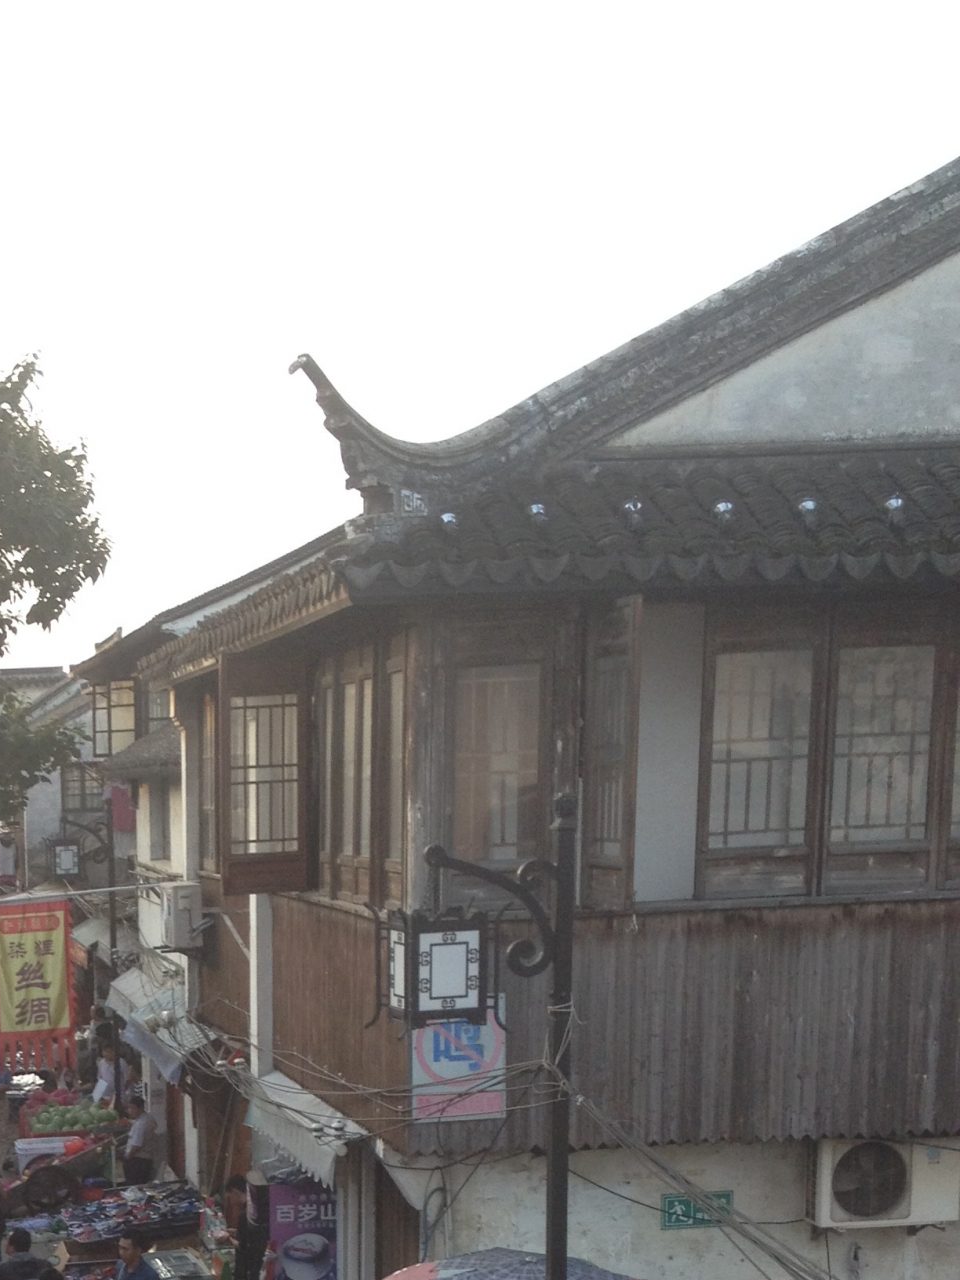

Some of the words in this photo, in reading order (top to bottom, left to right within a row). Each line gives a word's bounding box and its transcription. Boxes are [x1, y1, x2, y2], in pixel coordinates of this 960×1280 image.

[14, 961, 52, 1026] 丝绸
[276, 1203, 337, 1222] 百岁山
